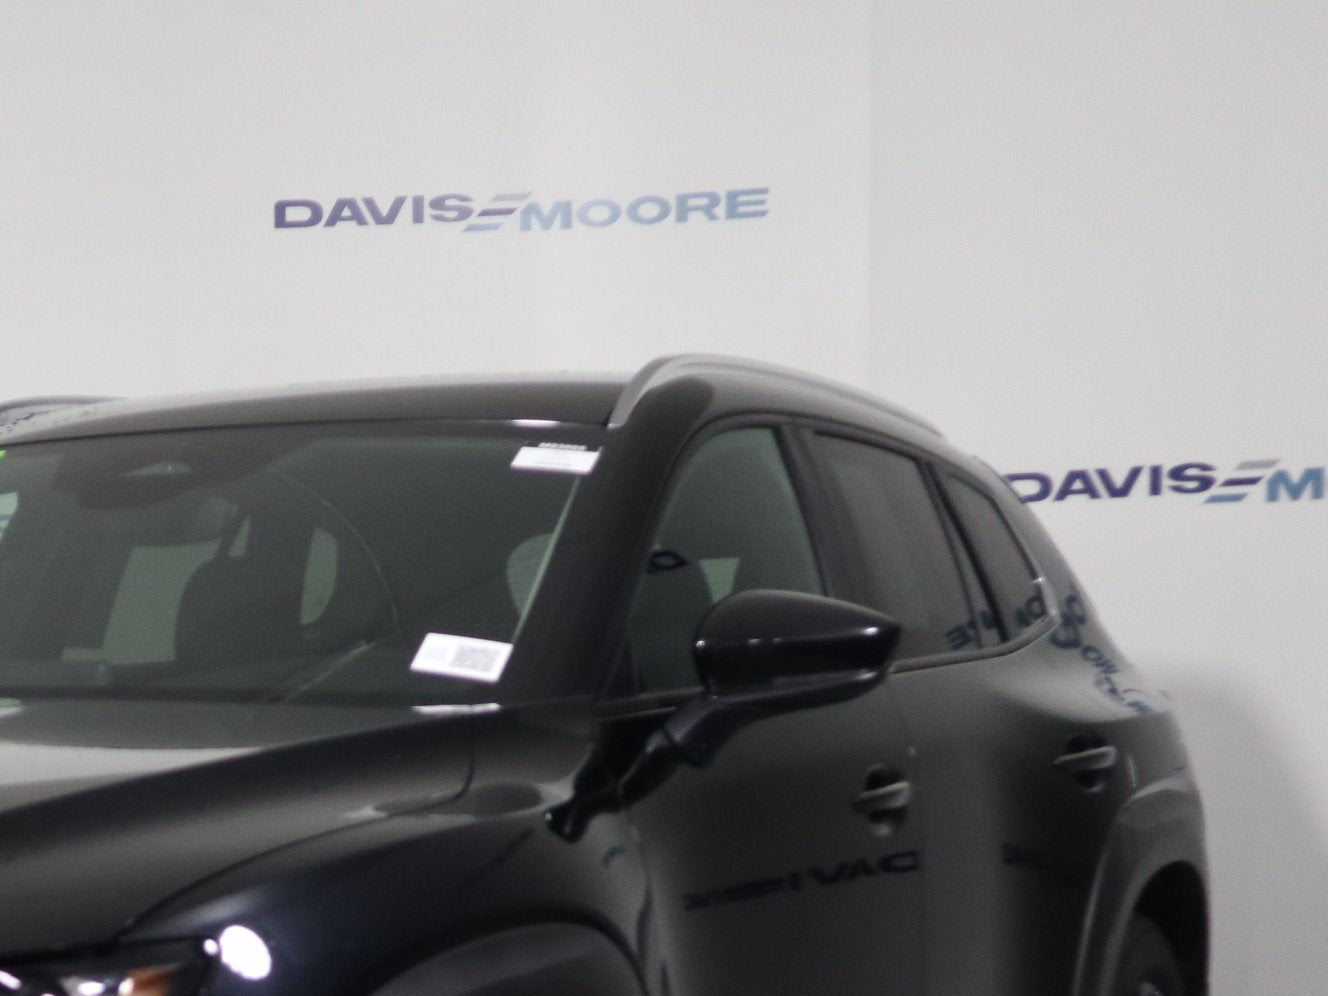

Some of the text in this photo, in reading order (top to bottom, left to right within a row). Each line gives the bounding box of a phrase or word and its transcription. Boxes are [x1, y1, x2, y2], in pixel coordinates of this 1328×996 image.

[273, 187, 770, 232] DAVIS MOORE
[1004, 462, 1217, 504] DAVIS
